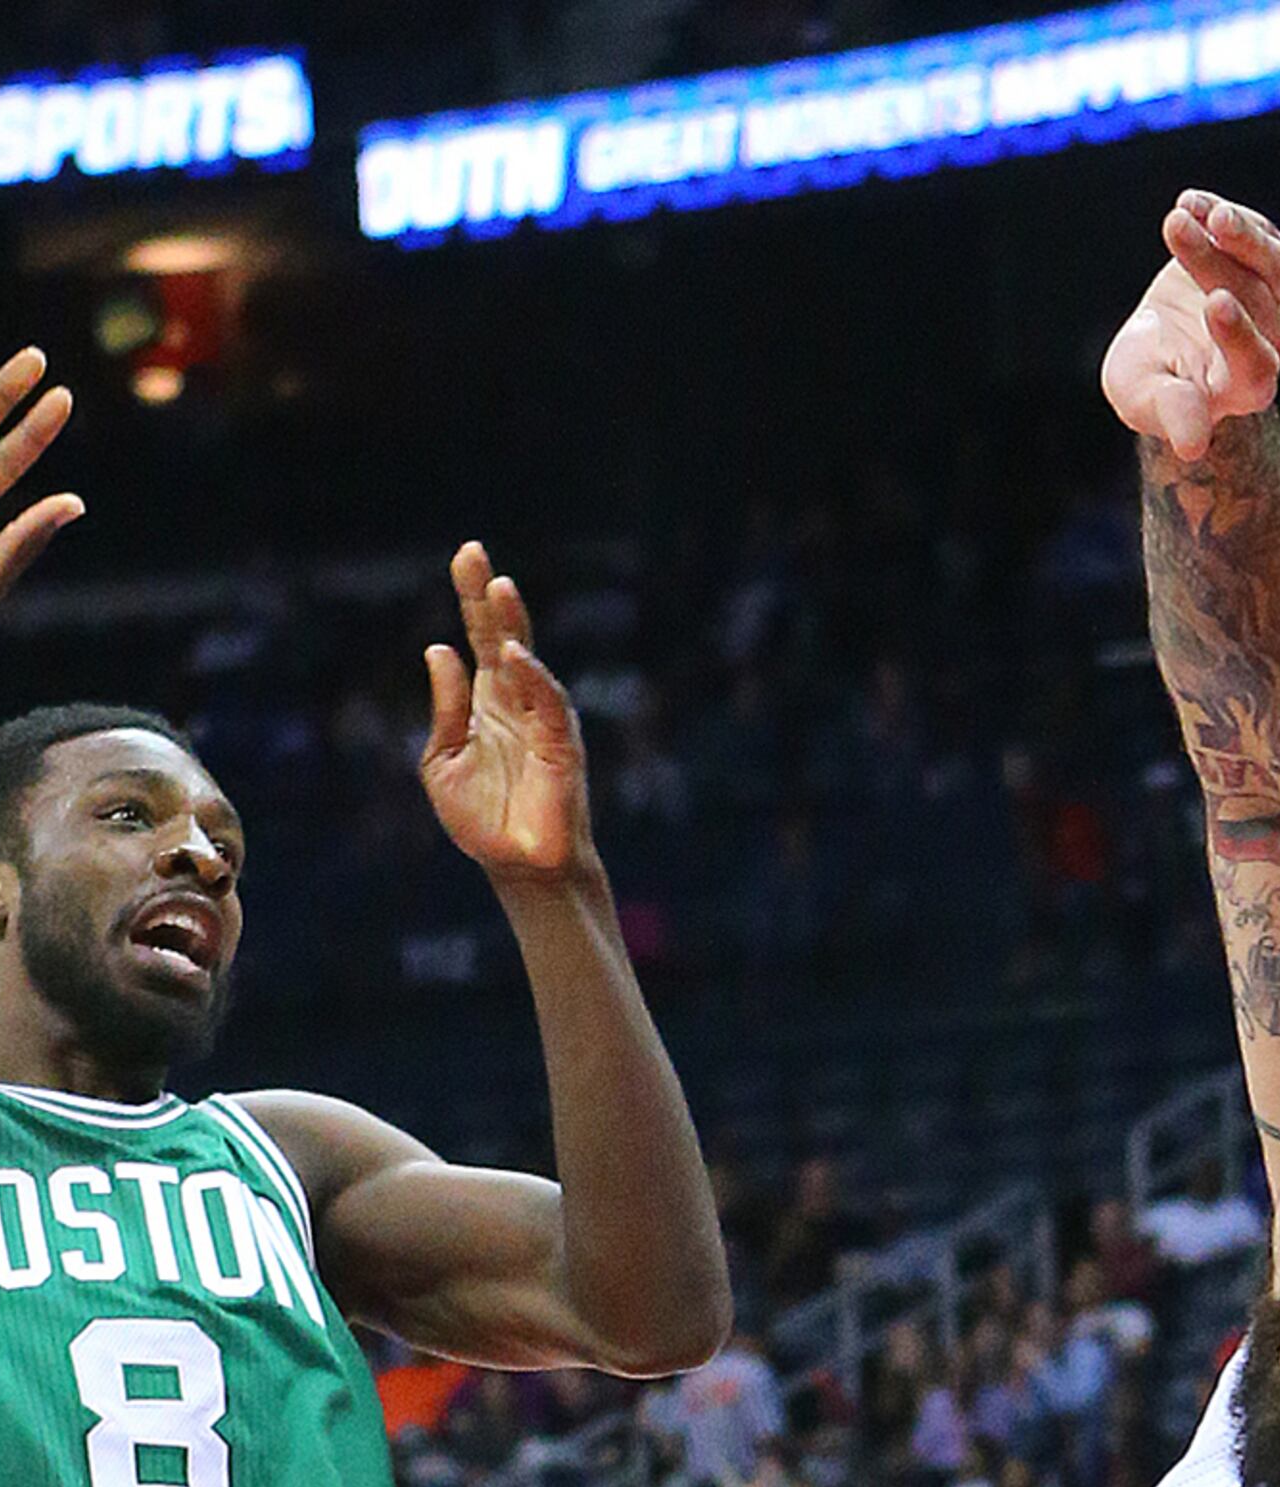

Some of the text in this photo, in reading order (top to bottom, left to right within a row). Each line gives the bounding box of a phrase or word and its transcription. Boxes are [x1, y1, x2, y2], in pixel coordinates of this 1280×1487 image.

[578, 108, 737, 192] GREAT
[741, 70, 984, 167] MOMENTS
[991, 32, 1188, 127] HAPPEN
